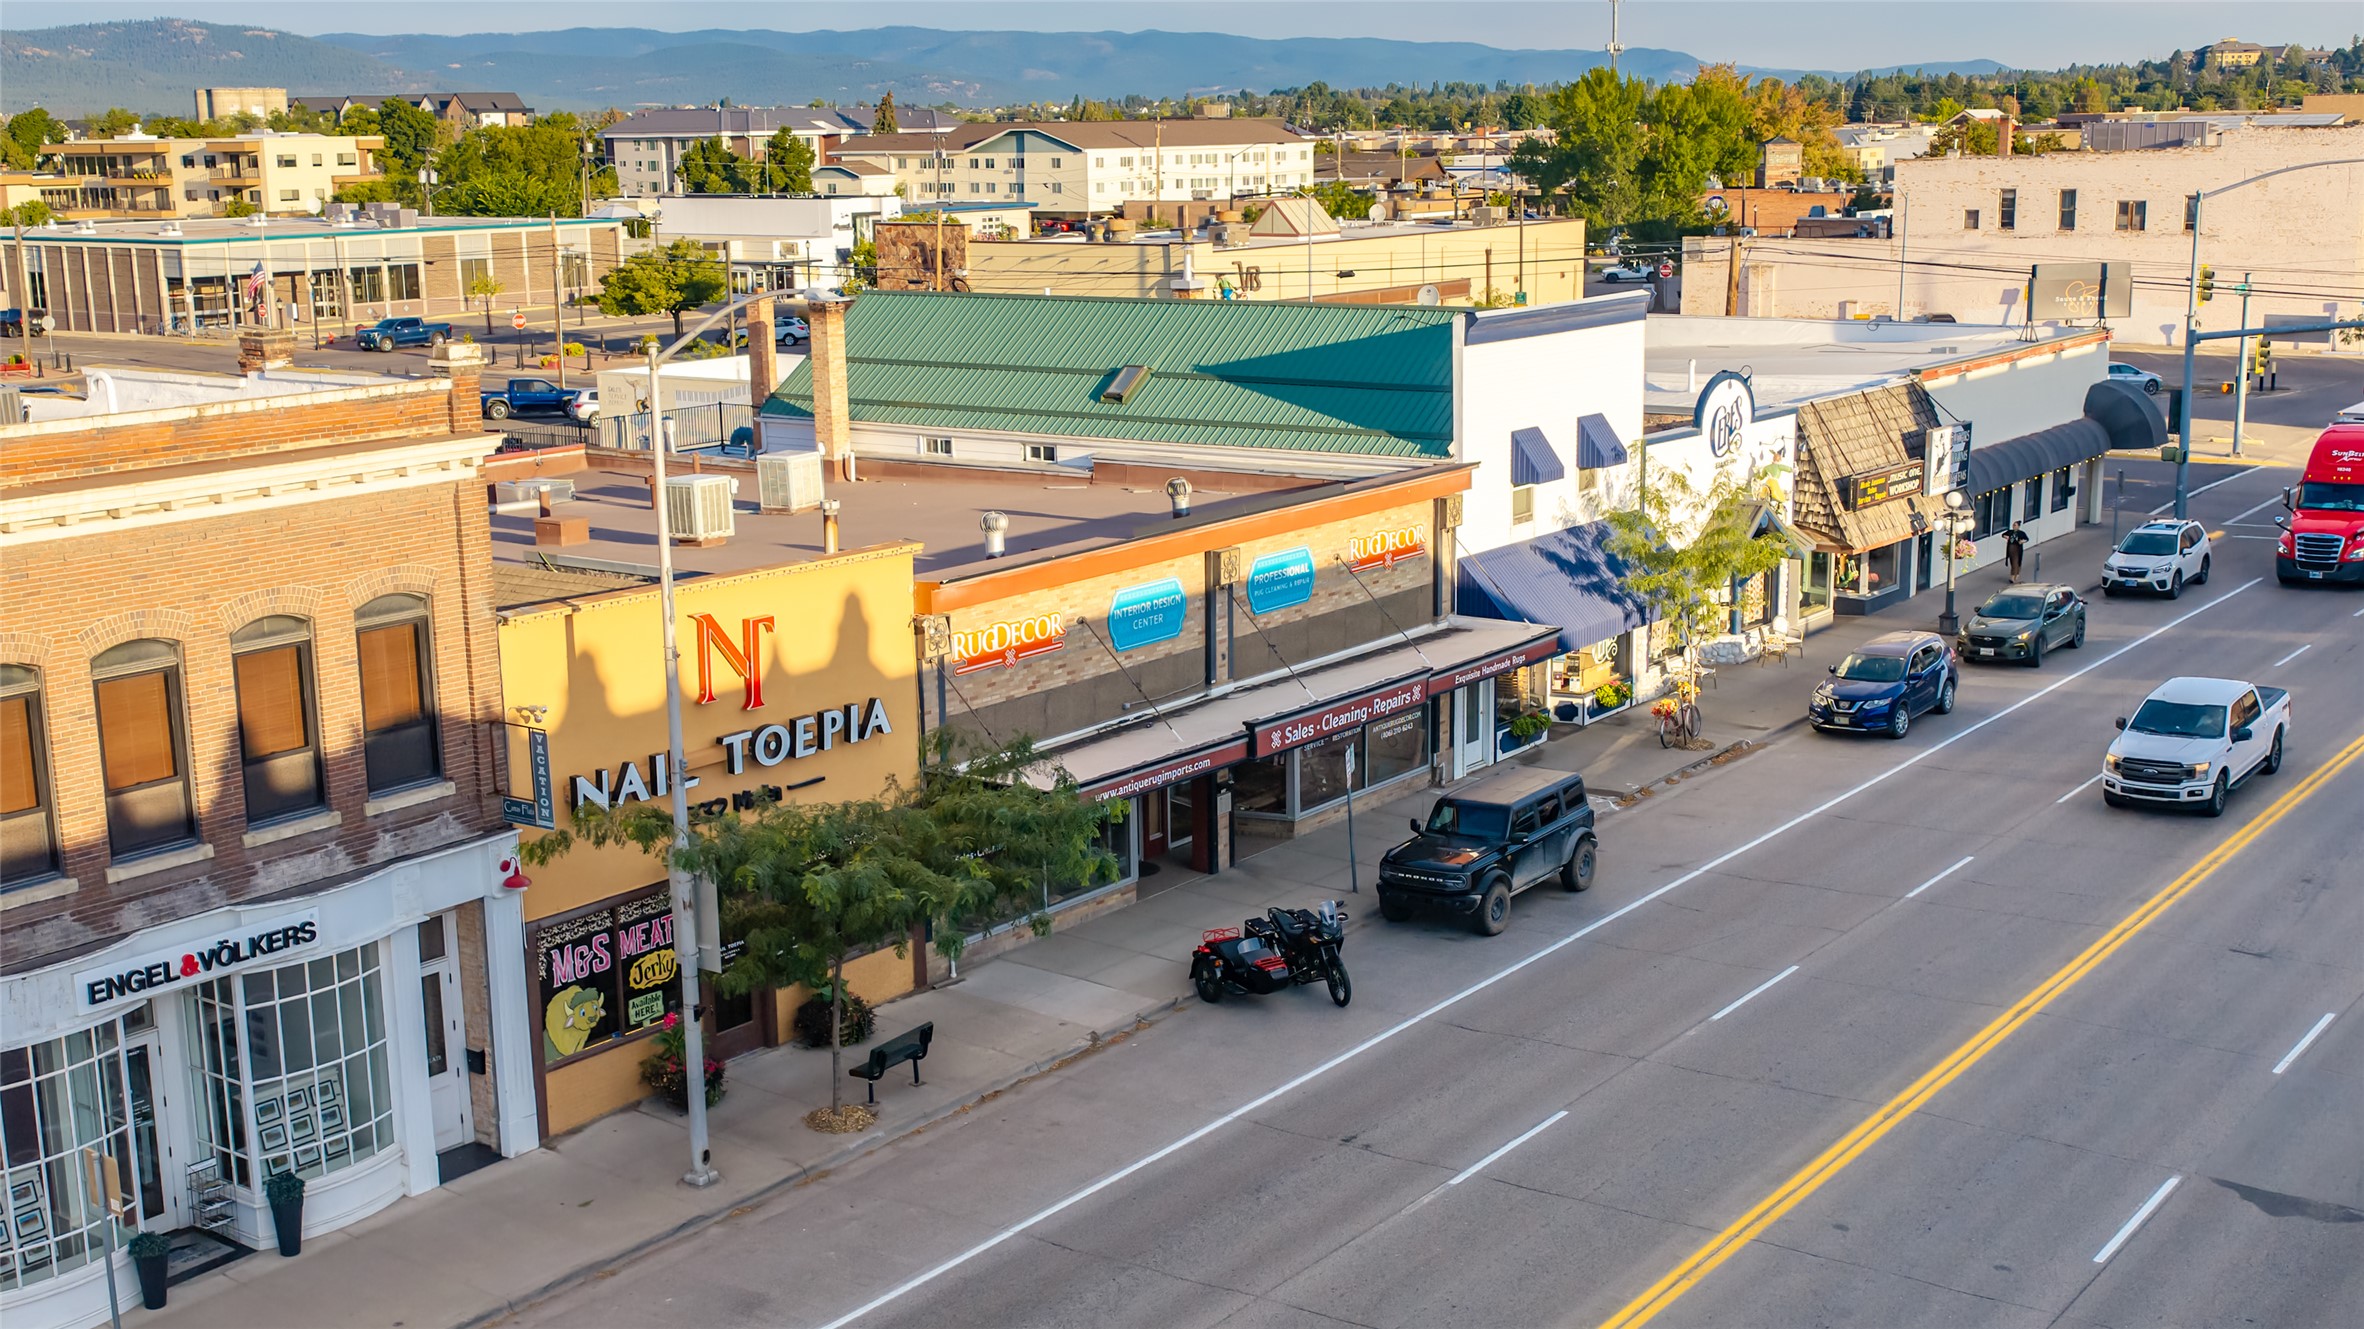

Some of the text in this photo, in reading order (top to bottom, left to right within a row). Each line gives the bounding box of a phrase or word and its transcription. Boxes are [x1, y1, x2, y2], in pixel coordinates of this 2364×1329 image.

[1254, 562, 1310, 586] PROFESSIONAL
[1265, 582, 1288, 594] CLEANING
[1294, 577, 1310, 586] REPAIR
[1114, 594, 1182, 620] INTERIOR DESIGN
[1132, 614, 1164, 630] CENTER
[1455, 654, 1526, 685] Exquisite Handmade Rugs
[1285, 691, 1410, 744] Sales Cleaning Repairs
[716, 698, 892, 775] TOEPIA
[1304, 740, 1324, 752] SERVICE
[535, 734, 550, 818] VACATION
[1095, 758, 1210, 802] www.antiquerugimports.com
[1398, 872, 1444, 882] BRONCO
[618, 914, 674, 960] MEAT
[632, 952, 676, 986] Jerky
[631, 993, 662, 1010] Available
[635, 1004, 659, 1018] HERE!
